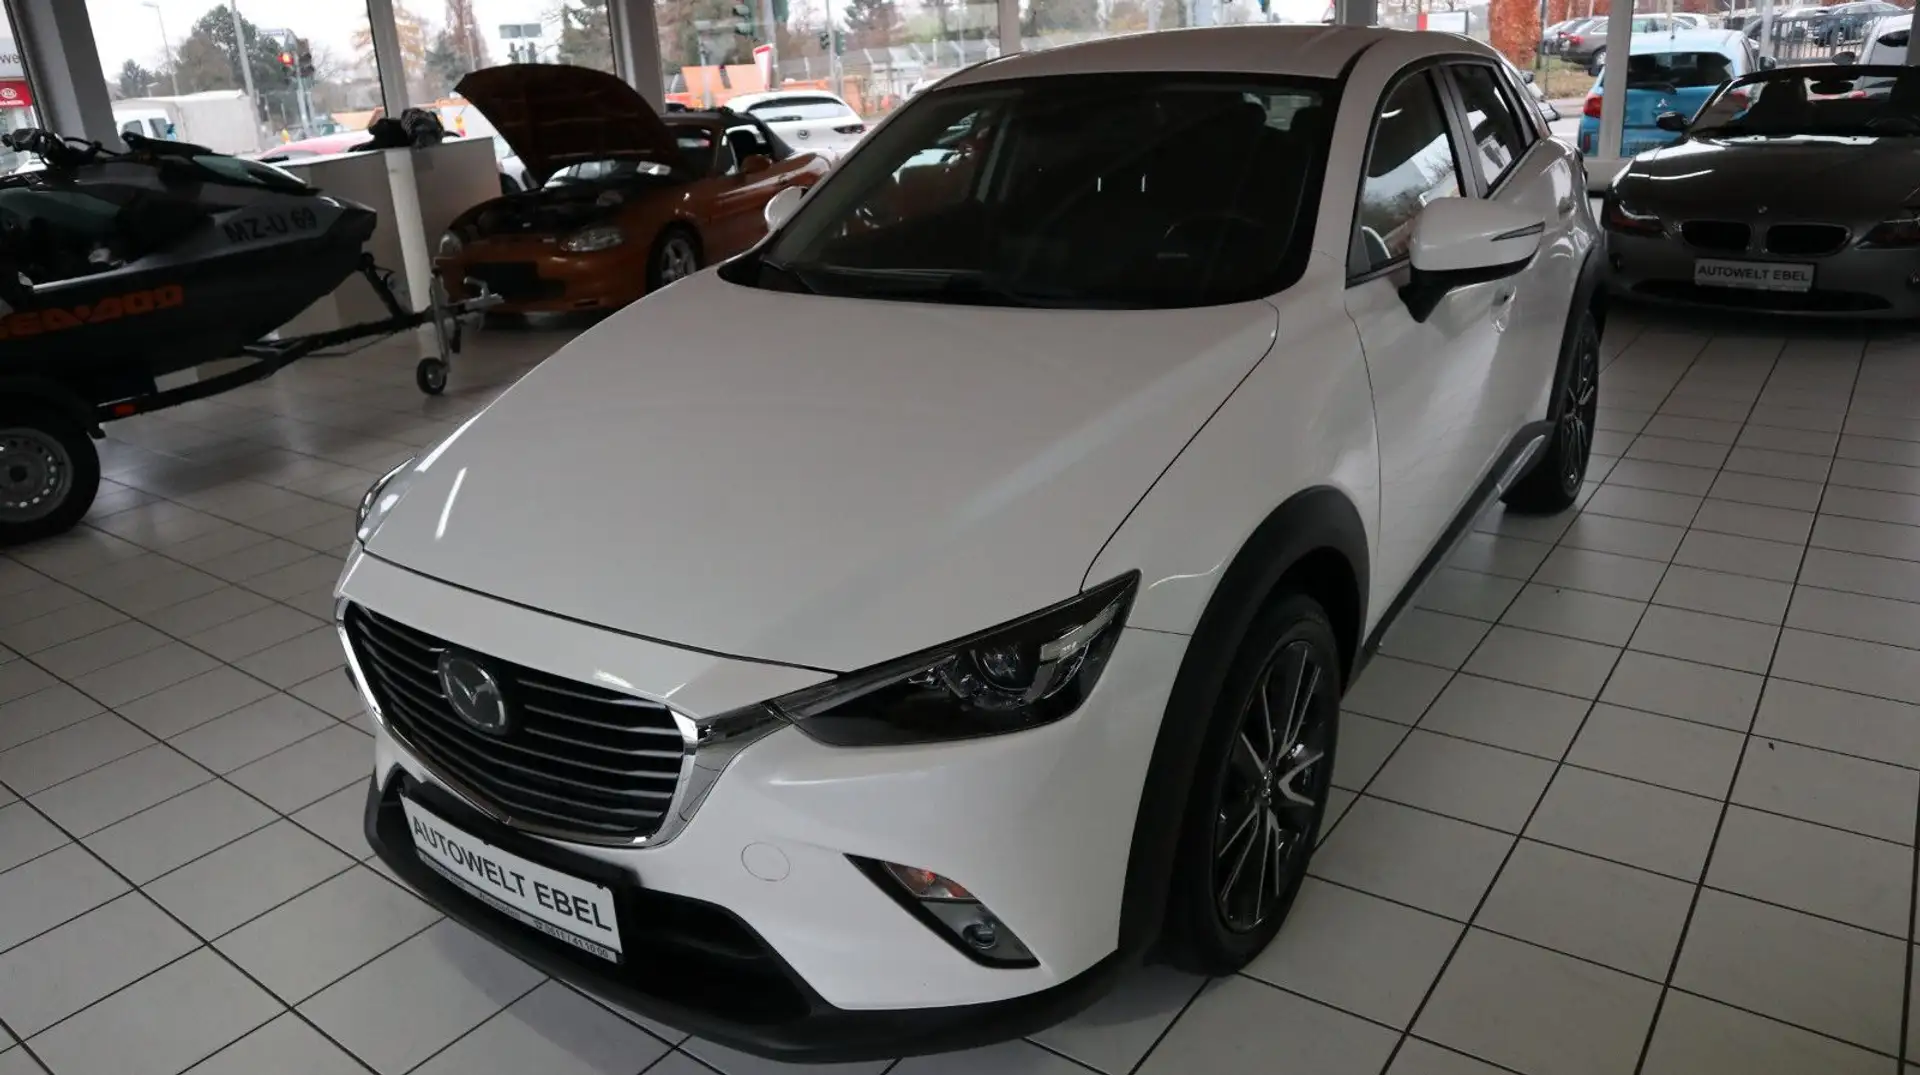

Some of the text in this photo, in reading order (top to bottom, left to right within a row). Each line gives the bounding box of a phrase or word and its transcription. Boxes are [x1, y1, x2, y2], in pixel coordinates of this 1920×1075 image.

[222, 207, 317, 241] MZ-U 69
[1697, 264, 1809, 281] AUTOWELT EBEL
[413, 815, 525, 897] AUTOWELT
[533, 881, 613, 932] EBEL
